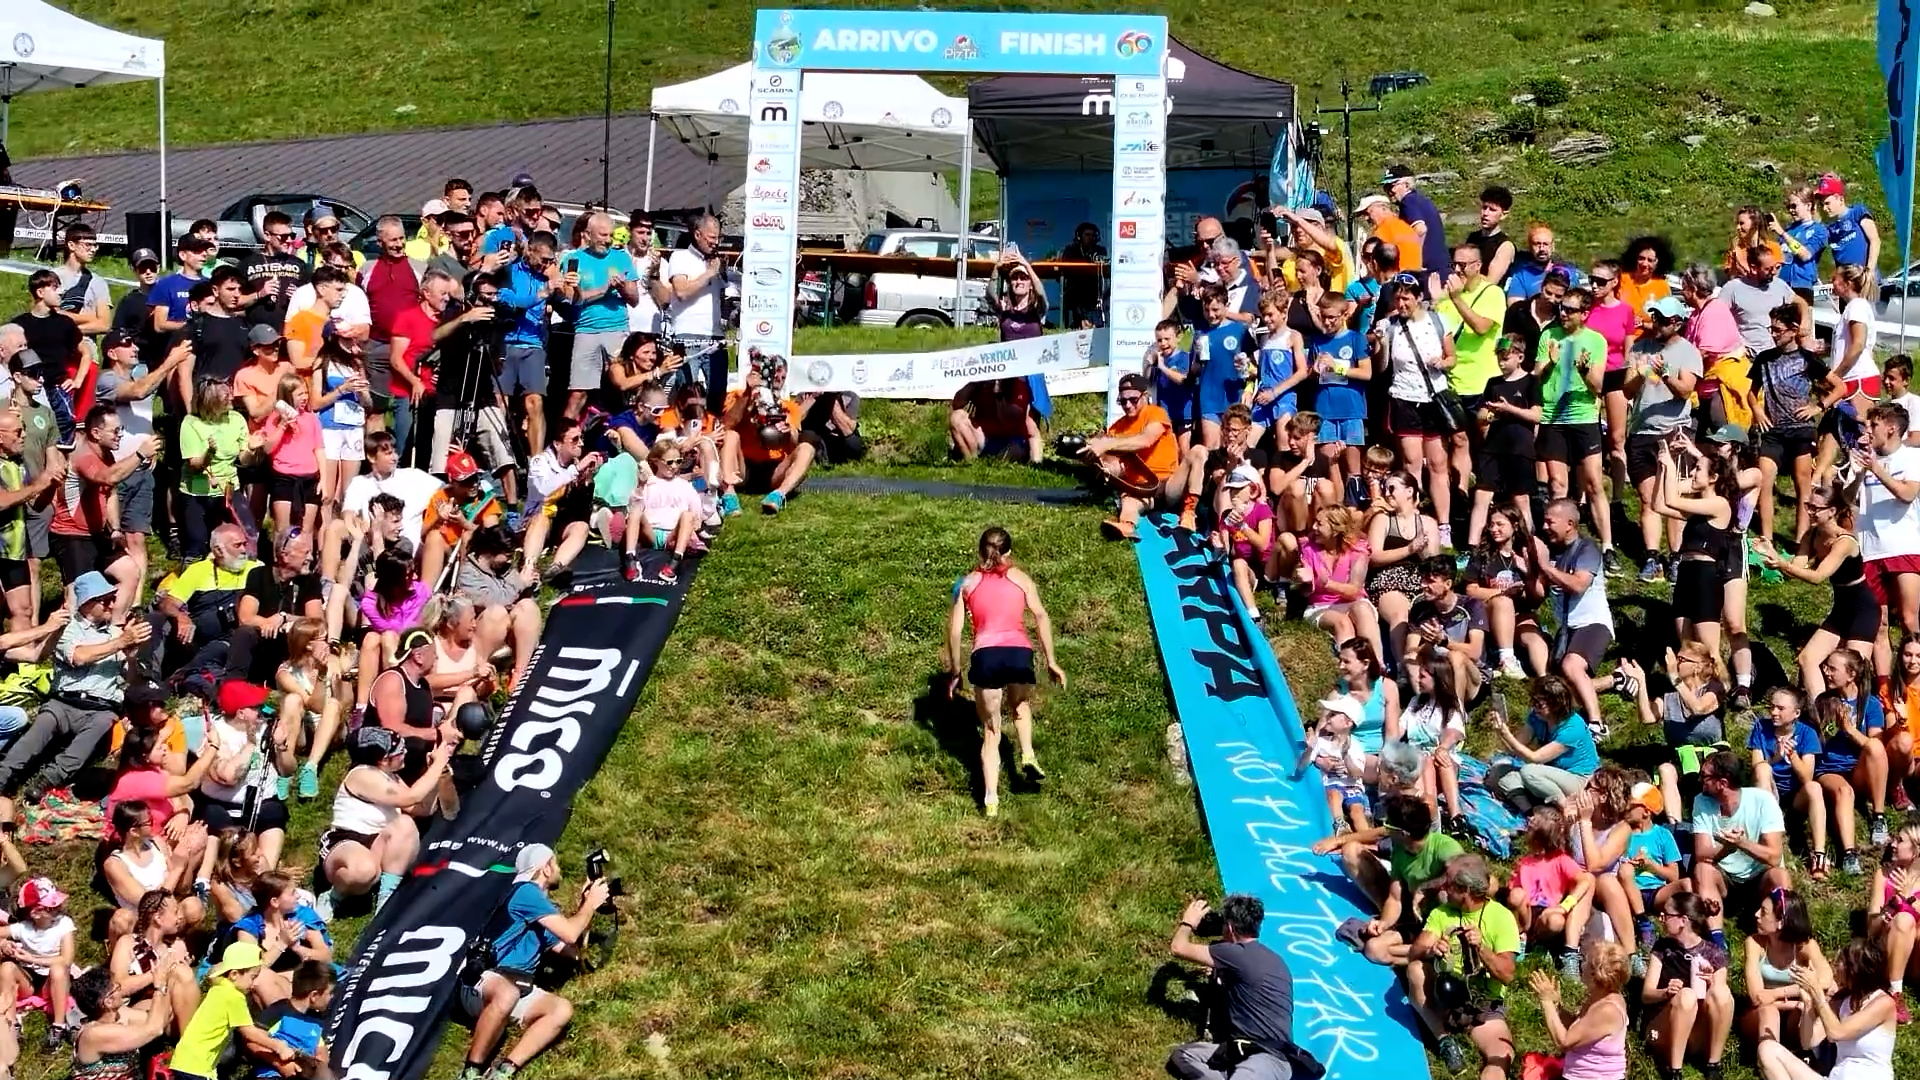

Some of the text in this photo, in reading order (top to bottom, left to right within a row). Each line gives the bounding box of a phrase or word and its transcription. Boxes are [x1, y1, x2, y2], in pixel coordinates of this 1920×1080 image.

[813, 28, 938, 53] ARRIVO
[1000, 31, 1106, 56] FINISH
[752, 213, 785, 231] abm
[247, 262, 300, 275] ASTEMIO
[980, 348, 1018, 364] VERTICAL
[944, 363, 1006, 378] MALONNO
[482, 722, 505, 766] PERFORM
[1215, 741, 1294, 791] NO
[1231, 794, 1333, 900] PLACE
[1263, 898, 1345, 967] TOO
[338, 925, 467, 1080] mic
